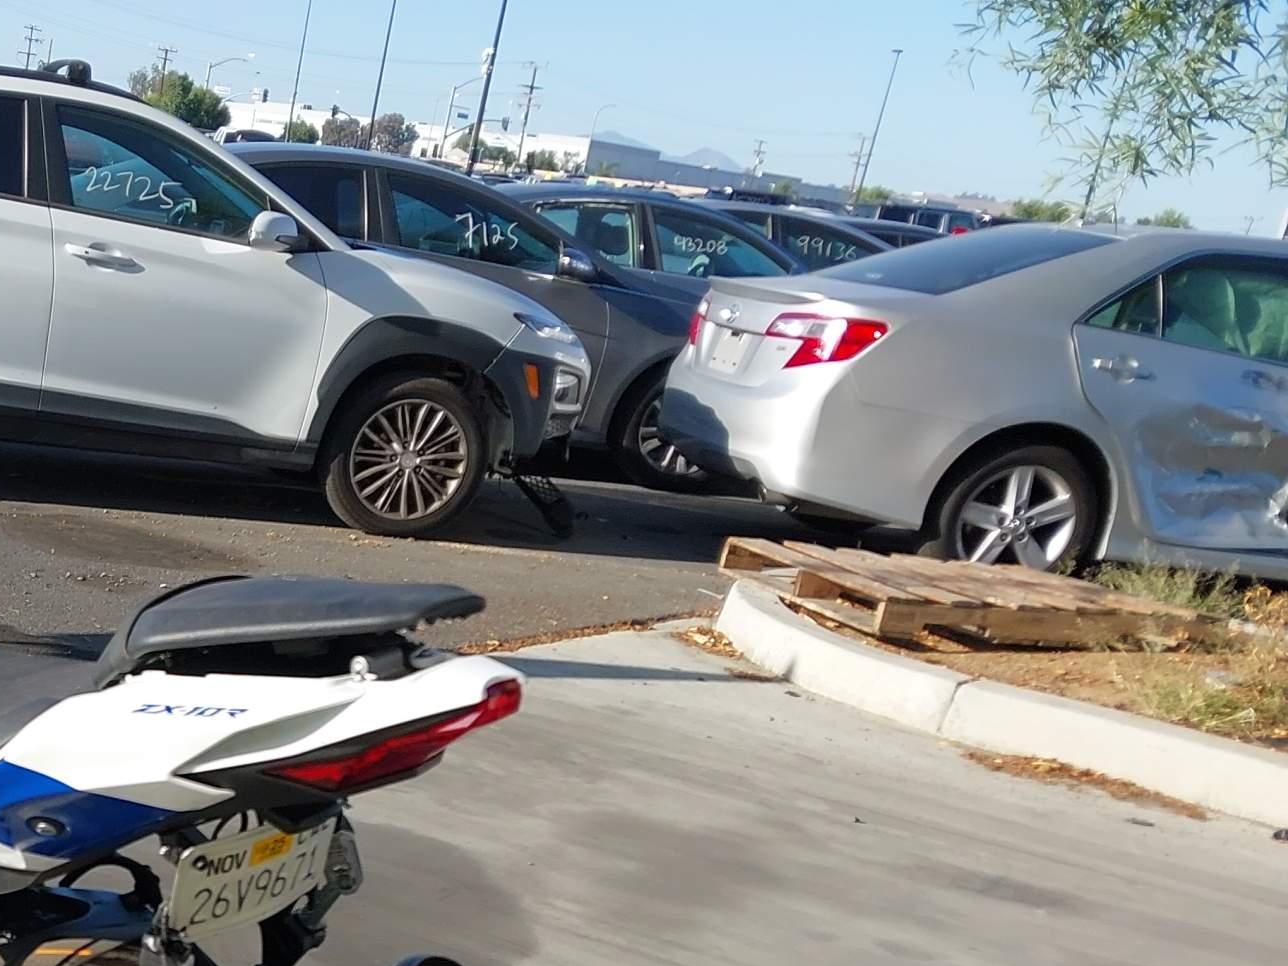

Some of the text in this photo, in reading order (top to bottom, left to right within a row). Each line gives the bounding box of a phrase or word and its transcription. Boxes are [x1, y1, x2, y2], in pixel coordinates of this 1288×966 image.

[85, 166, 183, 209] 22725
[455, 212, 520, 250] 7125
[797, 234, 857, 260] 99136
[132, 703, 249, 719] ZX-10R
[206, 850, 248, 878] NOV
[188, 846, 317, 925] 26V9671
